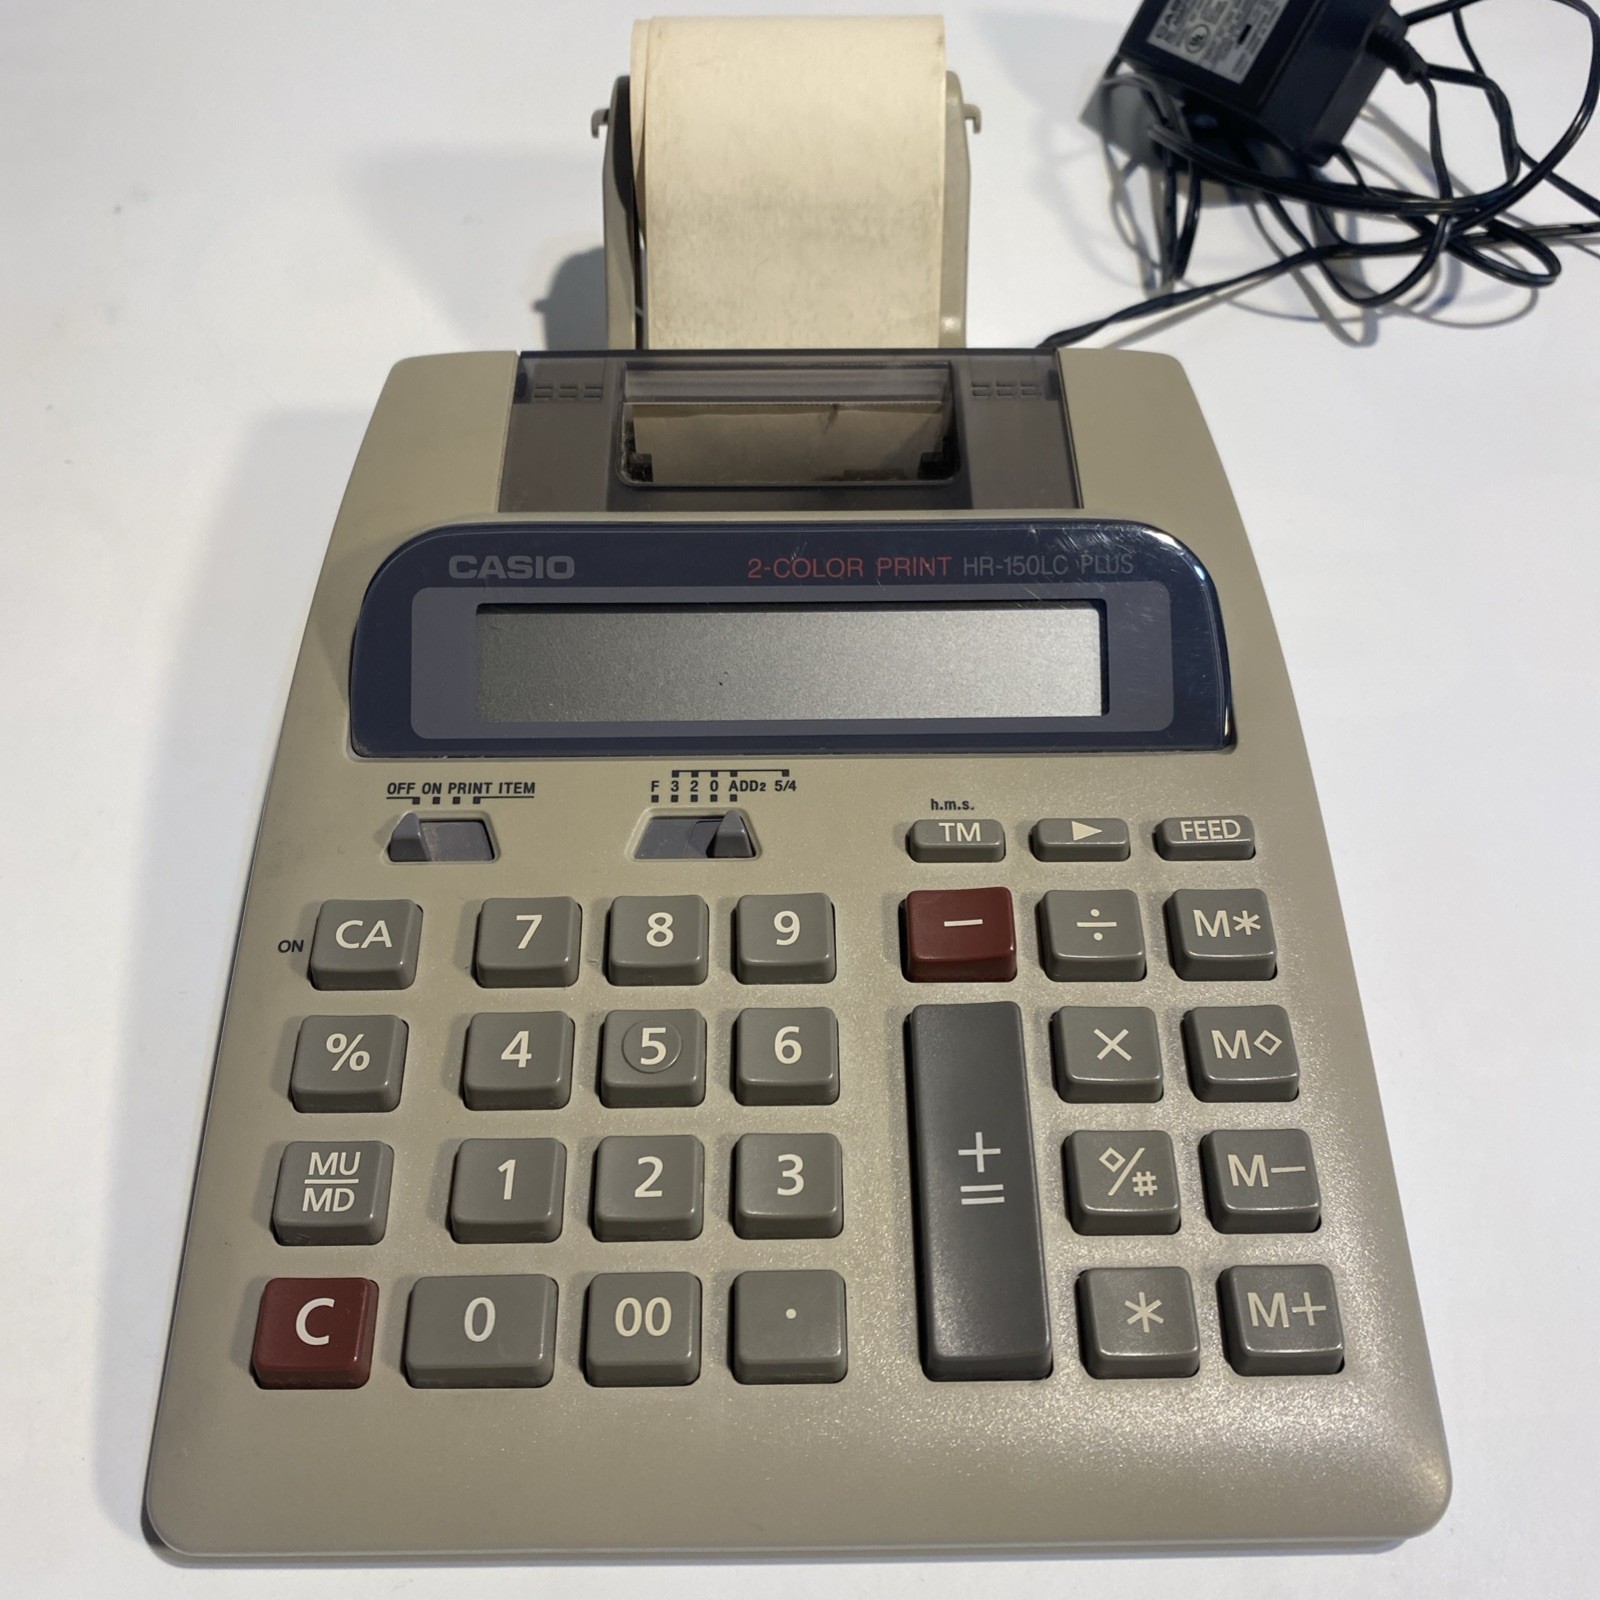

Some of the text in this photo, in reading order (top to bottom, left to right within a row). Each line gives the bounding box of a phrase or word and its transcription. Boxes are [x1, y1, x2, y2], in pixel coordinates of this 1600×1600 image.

[448, 554, 577, 581] CASIO
[747, 552, 1135, 579] 2-COLOR PRINT HR-150LC PLUS
[387, 782, 536, 795] OFF ON PRINT ITEM
[651, 781, 659, 792] F
[671, 781, 679, 792] 3
[690, 780, 699, 792] 2
[774, 780, 797, 792] 5/4
[930, 799, 975, 811] h.m.s.
[939, 822, 981, 842] TM
[1180, 819, 1241, 841] FEED
[335, 920, 393, 949] CA
[515, 914, 543, 950] 7
[646, 912, 674, 947] 8
[773, 911, 801, 945] 9
[277, 940, 304, 954] ON
[325, 1033, 370, 1071] %
[501, 1030, 532, 1068] 4
[640, 1027, 667, 1065] 5
[774, 1026, 801, 1064] 6
[308, 1151, 360, 1175] MU
[497, 1159, 517, 1200] 1
[634, 1156, 664, 1198] 2
[776, 1153, 805, 1196] 3
[302, 1188, 355, 1212] MD
[295, 1297, 335, 1346] C
[464, 1296, 496, 1342] 0
[615, 1297, 672, 1337] 00
[1247, 1292, 1327, 1328] M+
